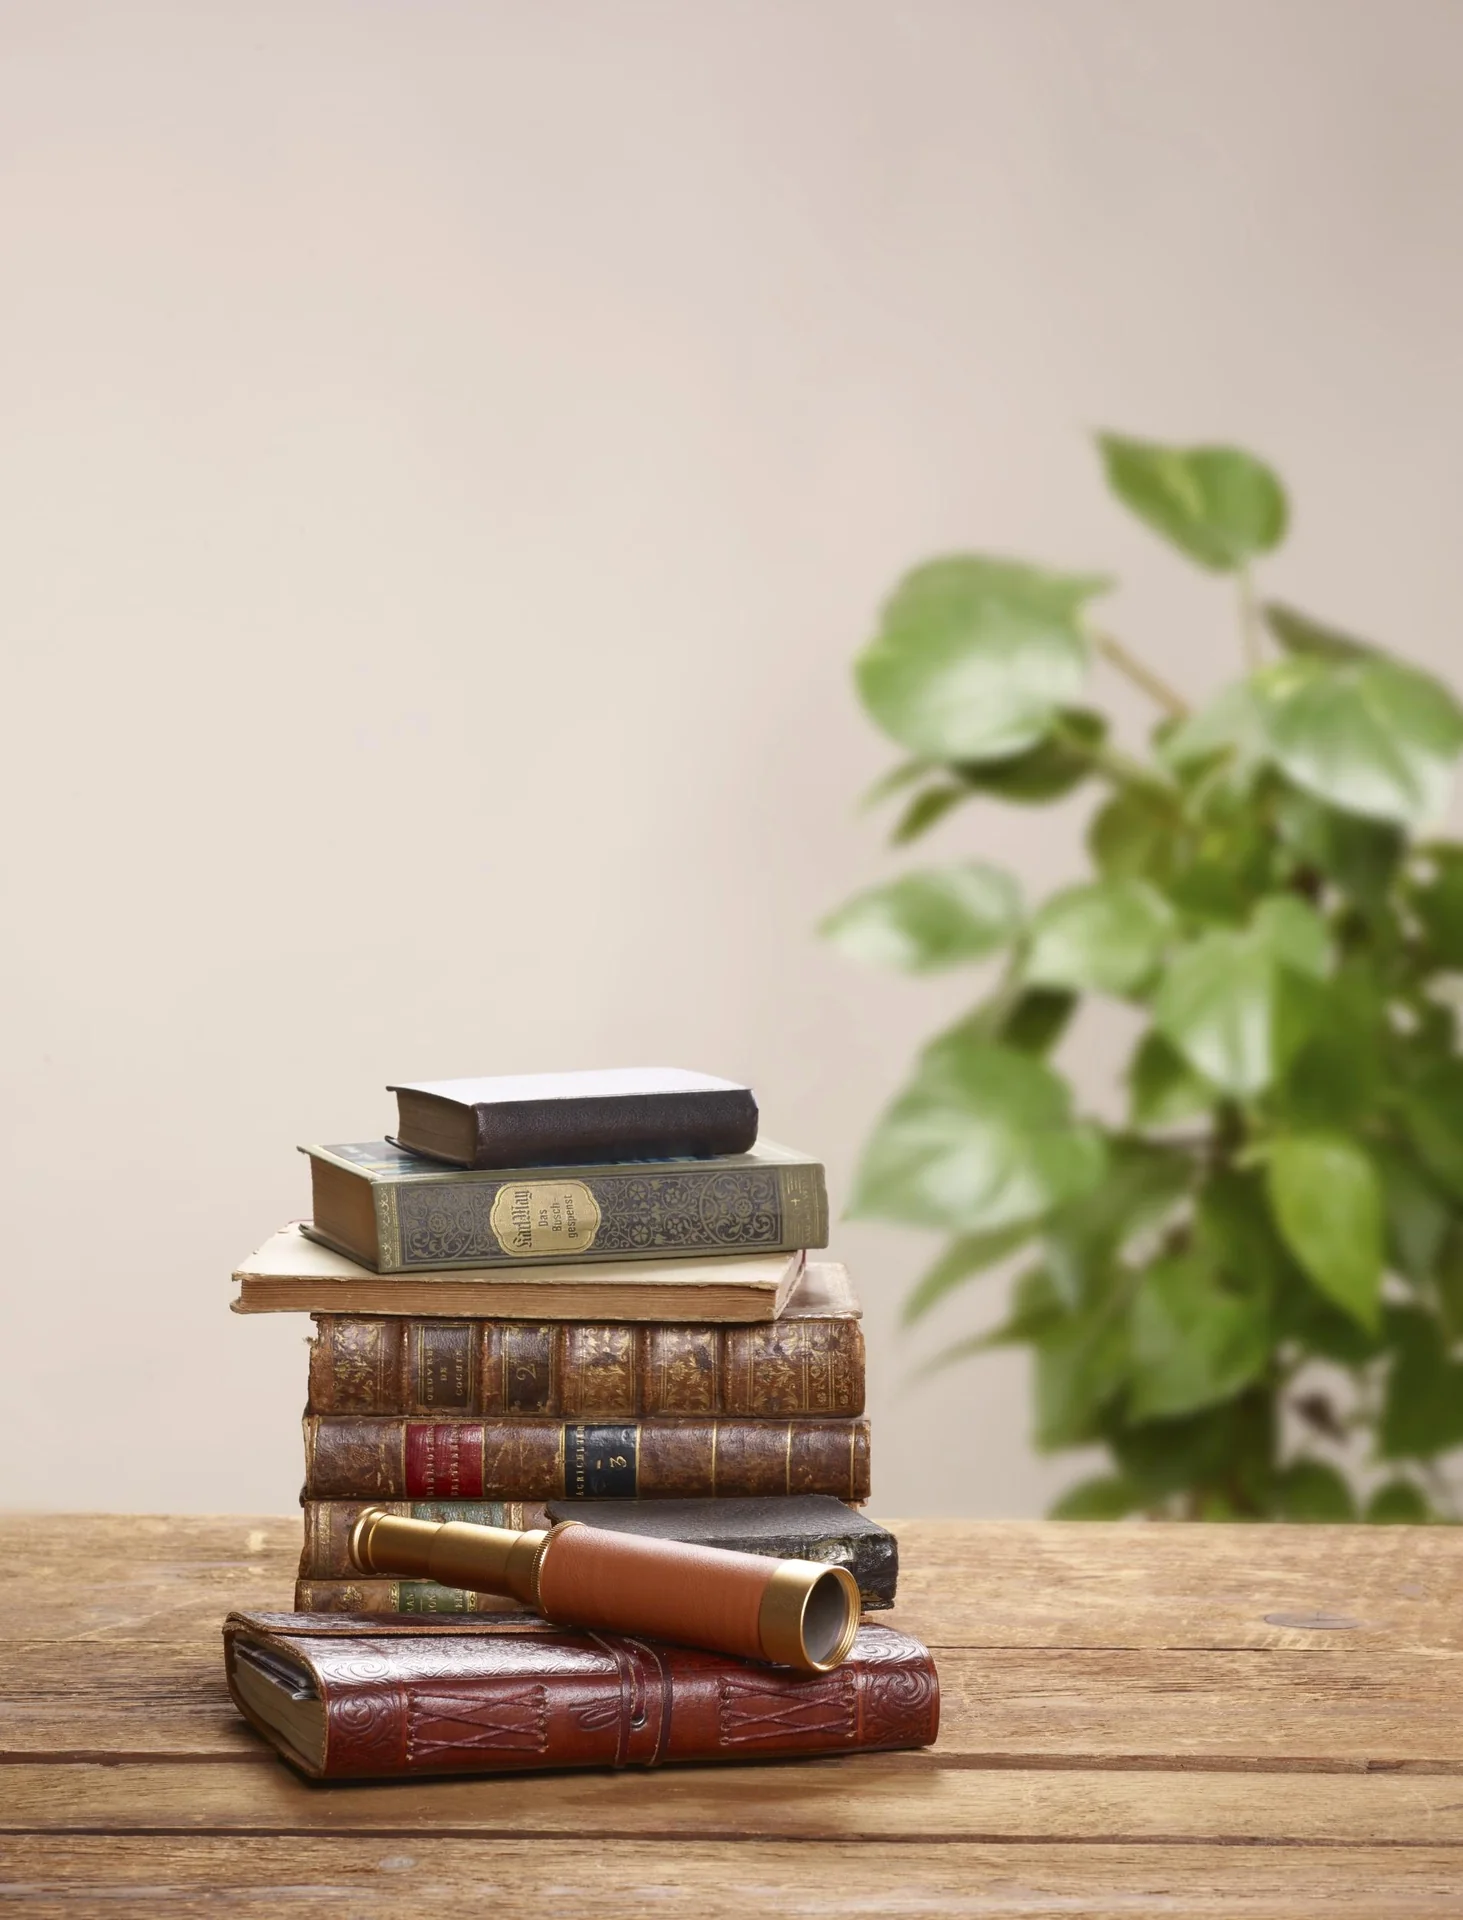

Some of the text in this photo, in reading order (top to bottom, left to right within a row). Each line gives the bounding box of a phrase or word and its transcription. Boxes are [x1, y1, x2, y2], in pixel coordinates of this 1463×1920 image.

[510, 1190, 533, 1248] Karl May
[538, 1209, 549, 1227] Das
[550, 1197, 562, 1232] Busch-
[564, 1194, 579, 1238] gespenst
[440, 1367, 448, 1381] DE
[516, 1363, 537, 1380] 2
[609, 1455, 627, 1468] 3
